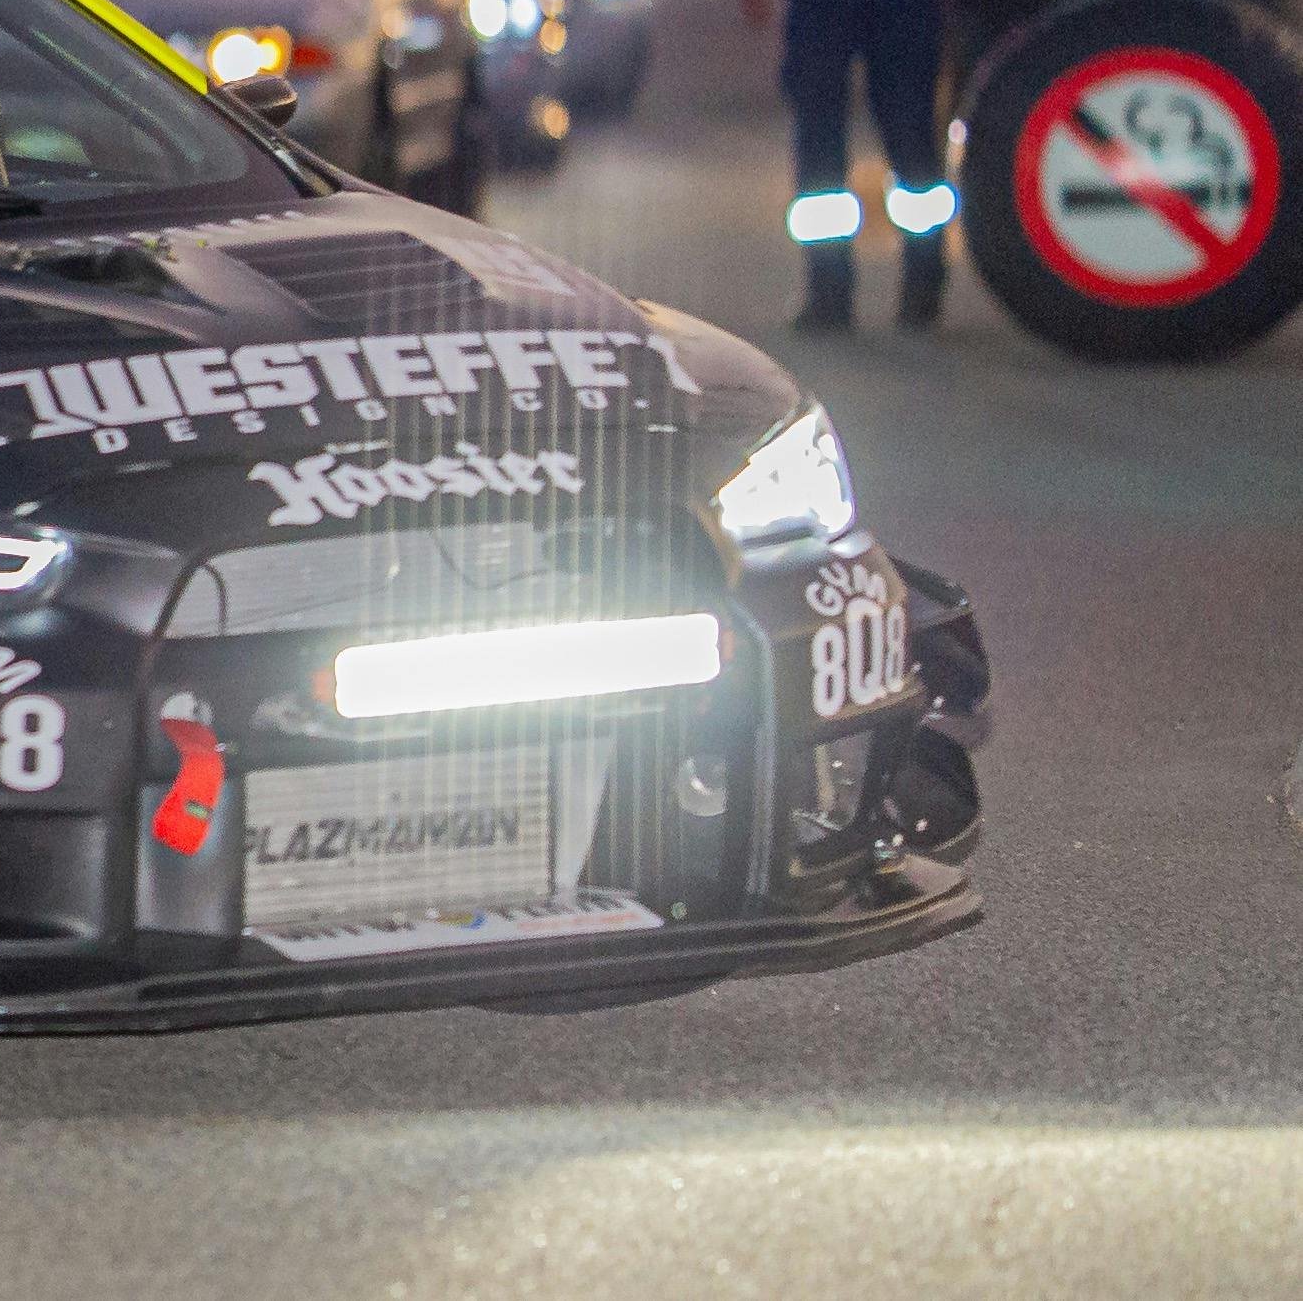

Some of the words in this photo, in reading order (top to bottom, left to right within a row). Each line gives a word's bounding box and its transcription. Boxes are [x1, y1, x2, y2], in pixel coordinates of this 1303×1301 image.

[93, 392, 457, 454] DESIGN
[247, 440, 584, 527] Hoosier
[804, 561, 888, 617] GYM
[810, 597, 908, 720] 8Q8
